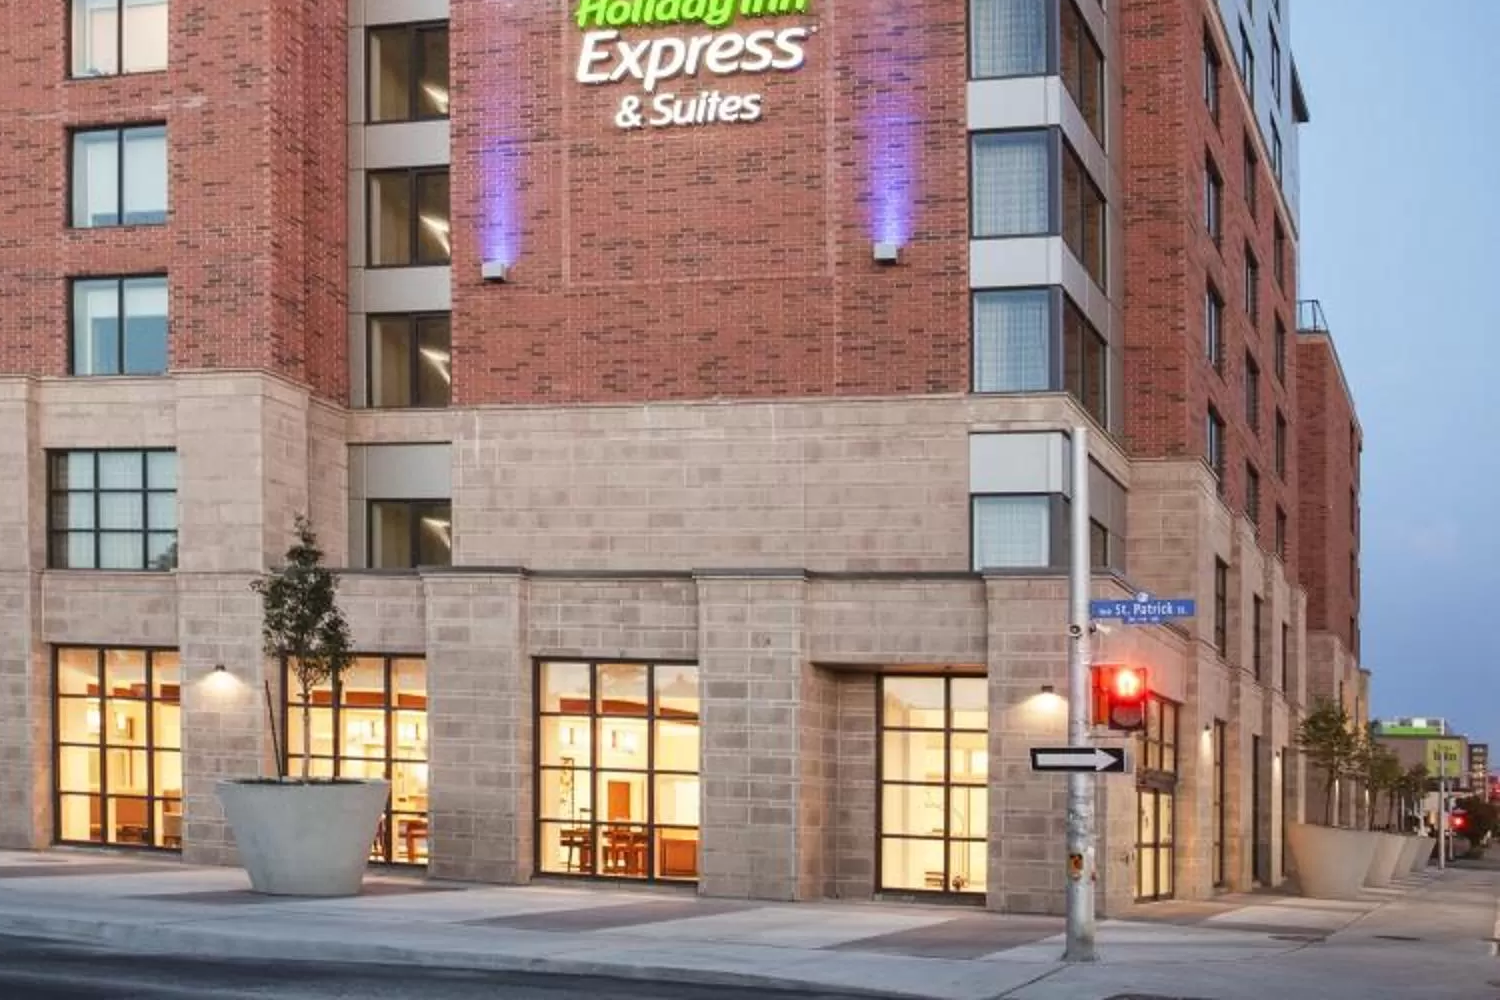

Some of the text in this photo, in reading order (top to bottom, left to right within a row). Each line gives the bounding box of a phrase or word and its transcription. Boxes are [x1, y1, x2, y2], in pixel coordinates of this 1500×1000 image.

[576, 27, 806, 92] Express
[615, 90, 762, 128] & Suites
[1115, 603, 1130, 616] St.
[1133, 602, 1173, 615] Patrick
